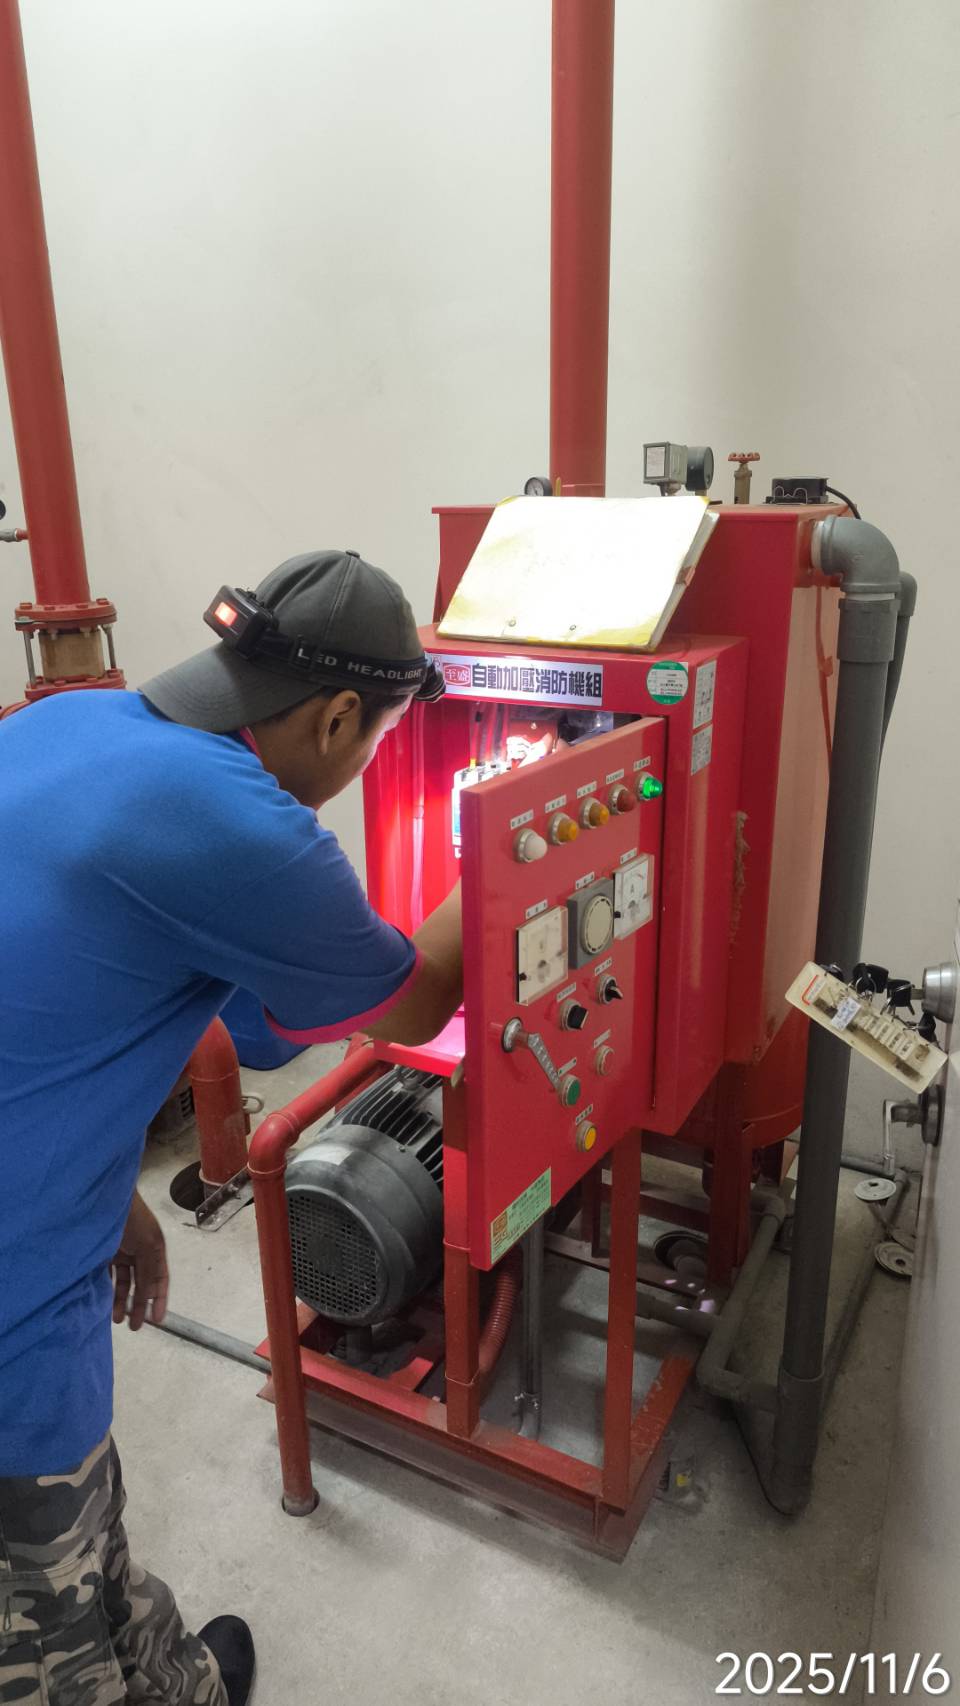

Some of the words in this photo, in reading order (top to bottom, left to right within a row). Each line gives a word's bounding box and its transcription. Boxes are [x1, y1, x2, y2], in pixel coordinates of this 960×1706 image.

[347, 661, 423, 681] HEADLIGHT
[472, 662, 602, 698] 自動加壓消防機組
